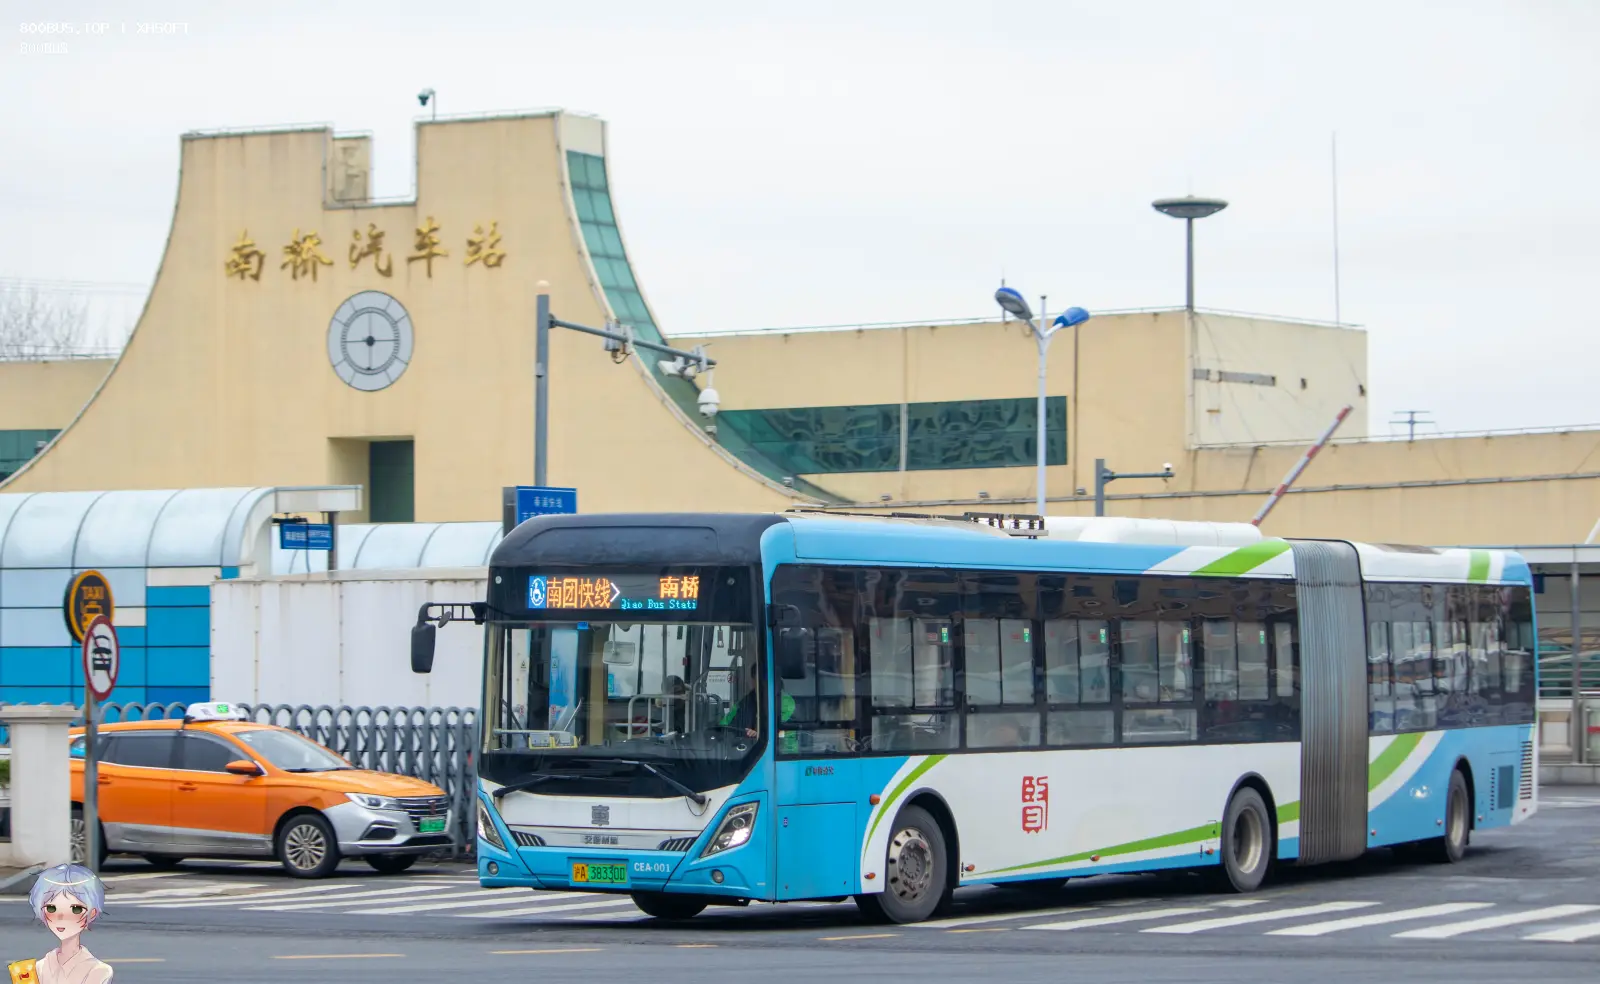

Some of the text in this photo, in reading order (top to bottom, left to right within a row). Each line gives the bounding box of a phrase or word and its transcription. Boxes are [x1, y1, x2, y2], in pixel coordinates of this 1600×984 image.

[80, 586, 105, 600] TAXI
[547, 576, 700, 609] 南团快线 南桥
[648, 598, 665, 609] Bus
